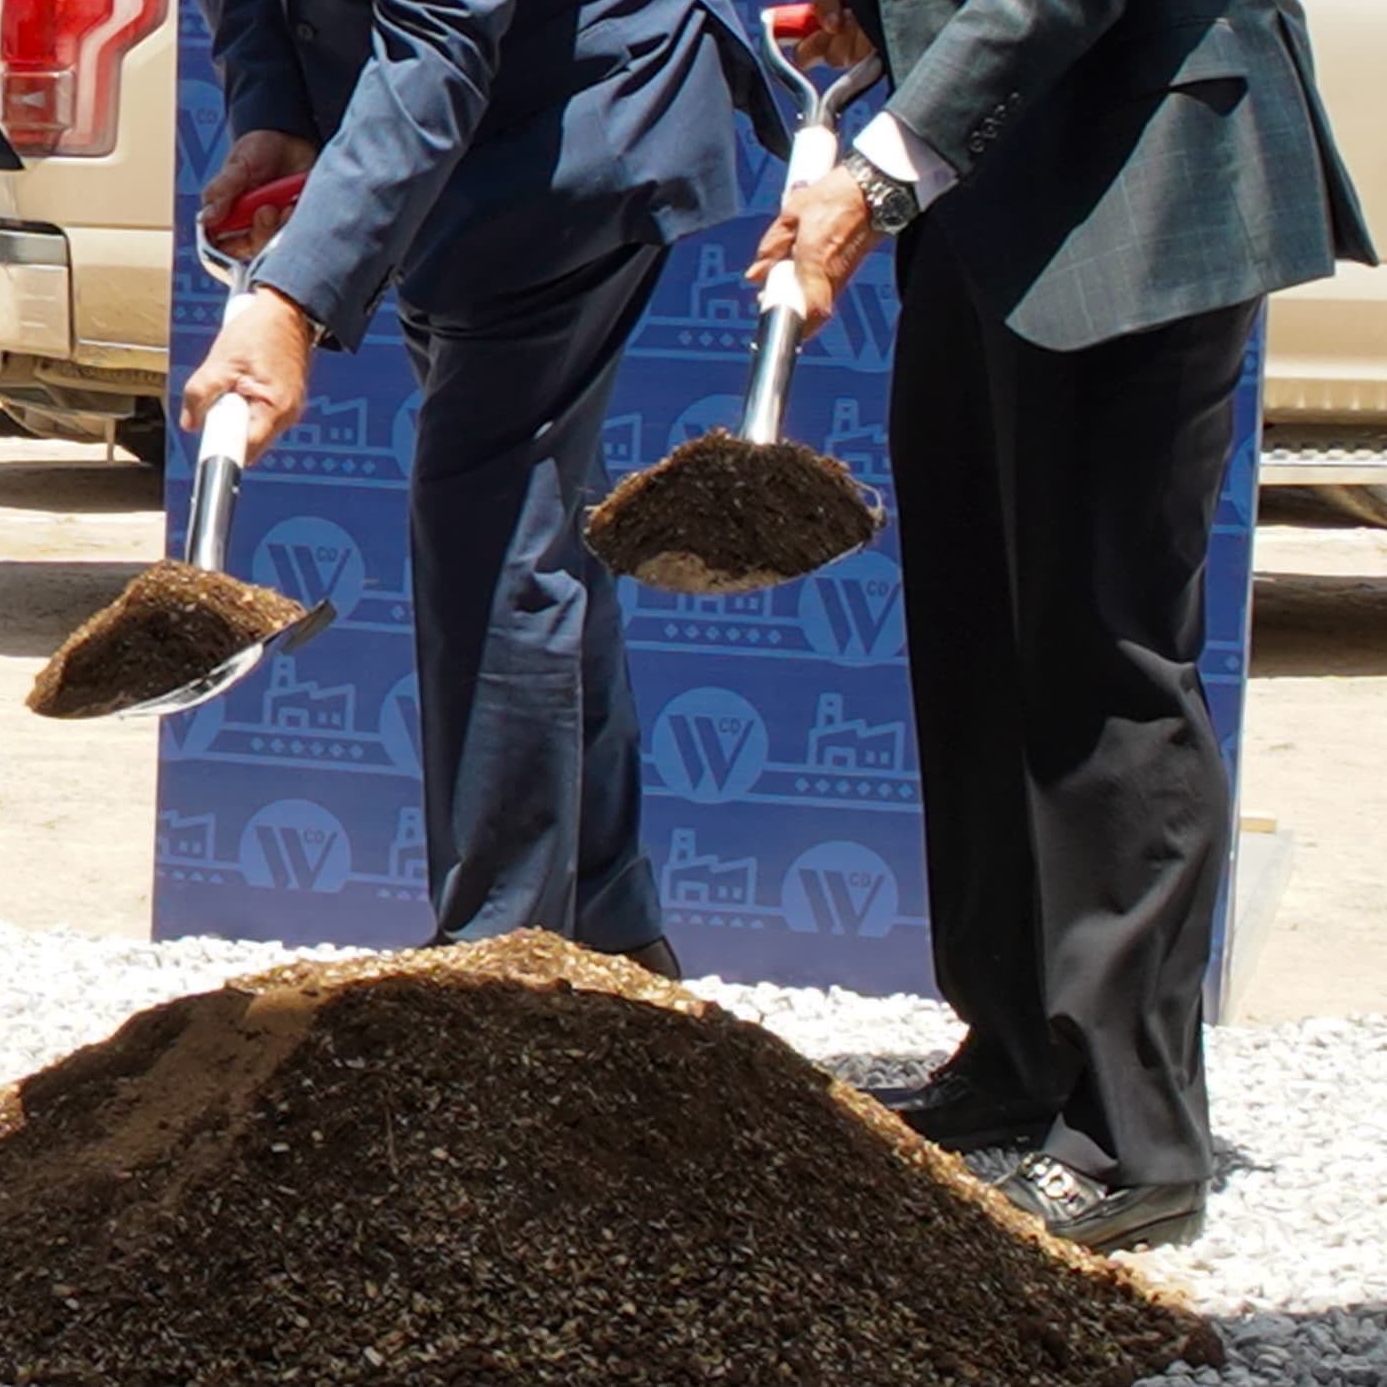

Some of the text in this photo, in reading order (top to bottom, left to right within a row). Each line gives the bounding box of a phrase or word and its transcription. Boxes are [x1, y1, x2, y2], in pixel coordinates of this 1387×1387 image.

[268, 543, 352, 607] W
[815, 577, 901, 656] W
[669, 715, 754, 790] W
[255, 825, 338, 889] W
[798, 869, 885, 935] W
